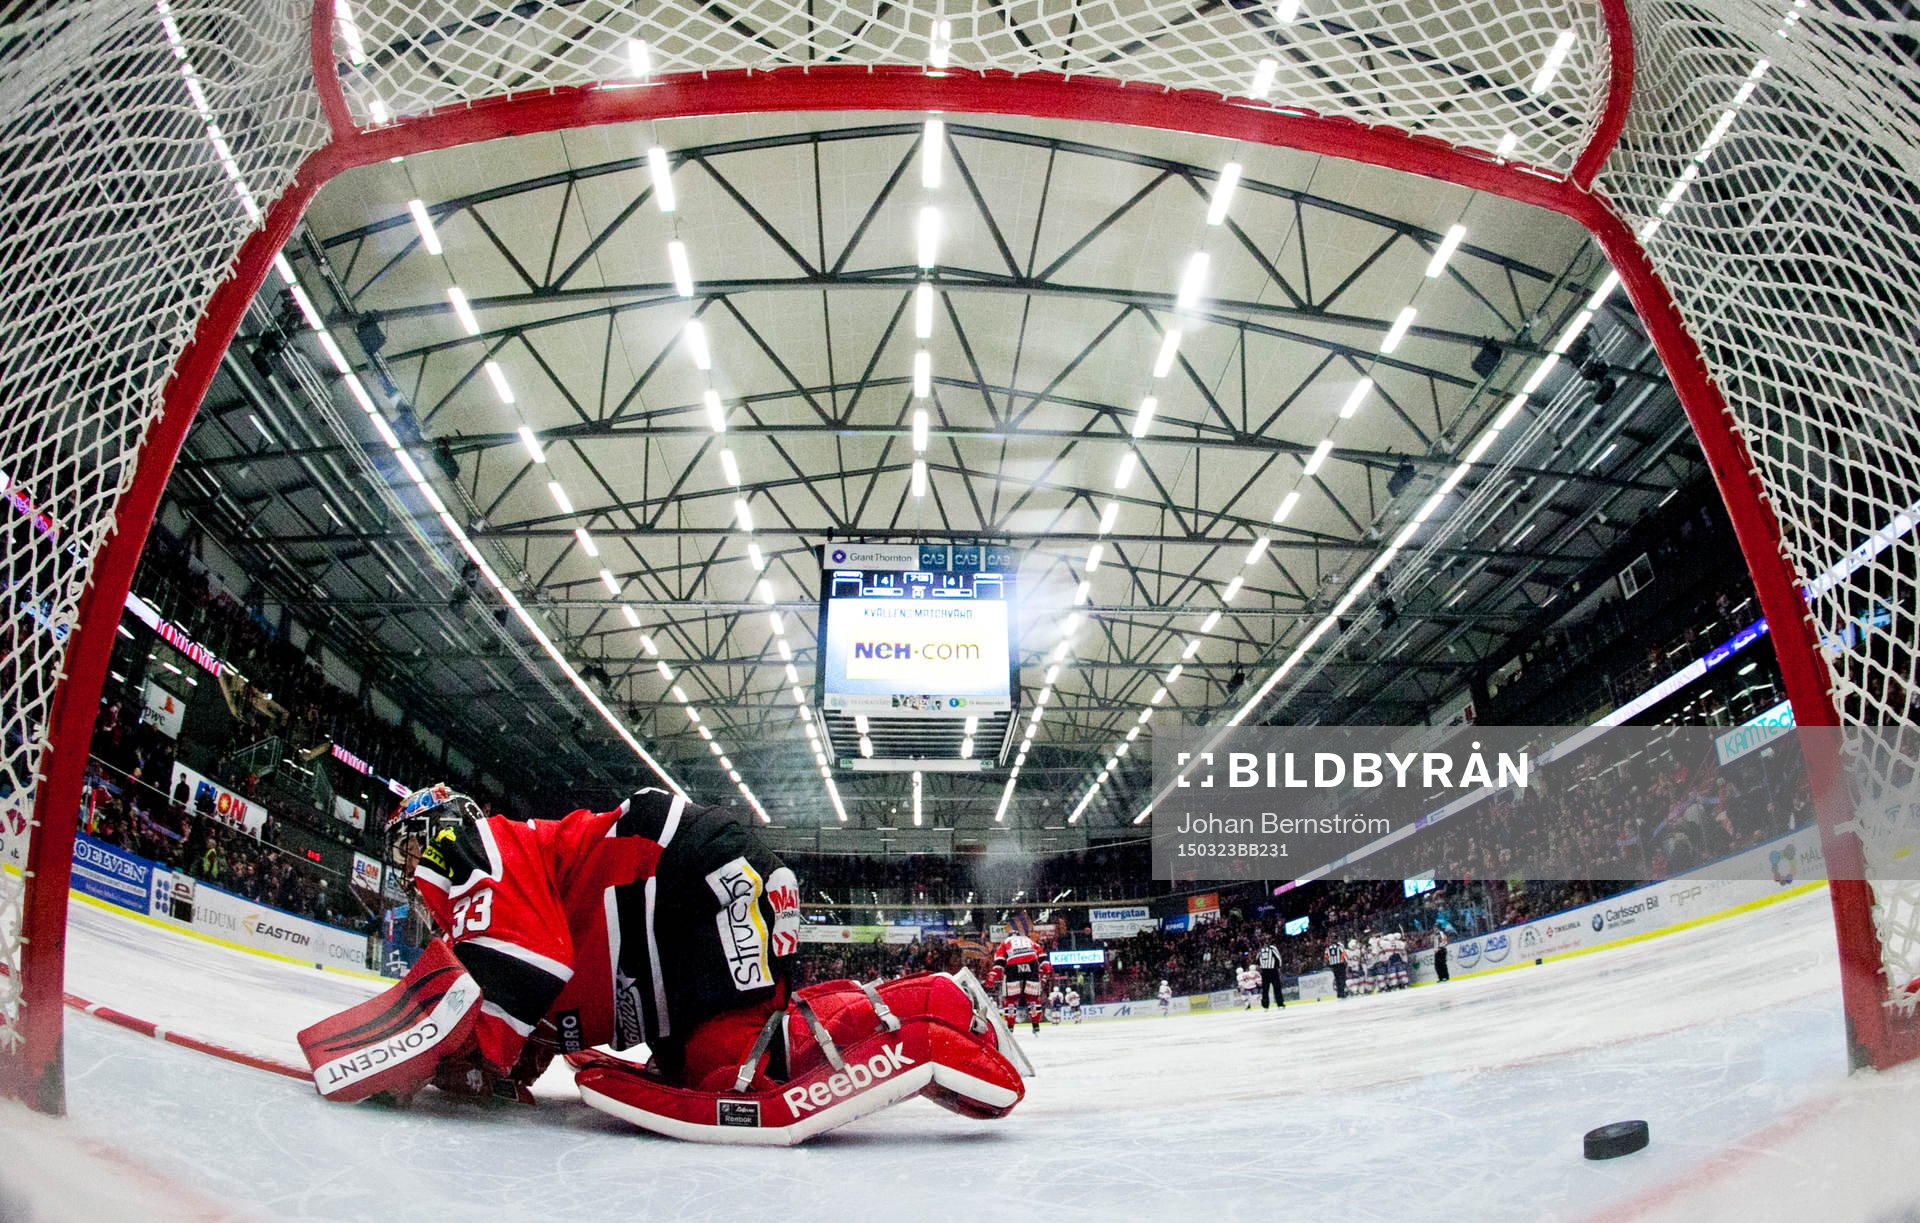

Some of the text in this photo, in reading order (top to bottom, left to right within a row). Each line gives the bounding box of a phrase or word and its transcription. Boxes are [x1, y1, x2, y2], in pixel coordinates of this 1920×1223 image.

[143, 706, 166, 727] pwc
[73, 838, 147, 884] OELVEN
[356, 859, 379, 880] ELON
[193, 907, 236, 932] LIDUM
[452, 887, 493, 938] 33
[1093, 909, 1145, 920] Vintergatan
[1605, 903, 1645, 922] Carlsson
[256, 922, 310, 947] EASTON
[328, 943, 366, 964] CONCEN
[329, 1023, 438, 1084] CONCENT
[783, 1041, 915, 1119] Reebok
